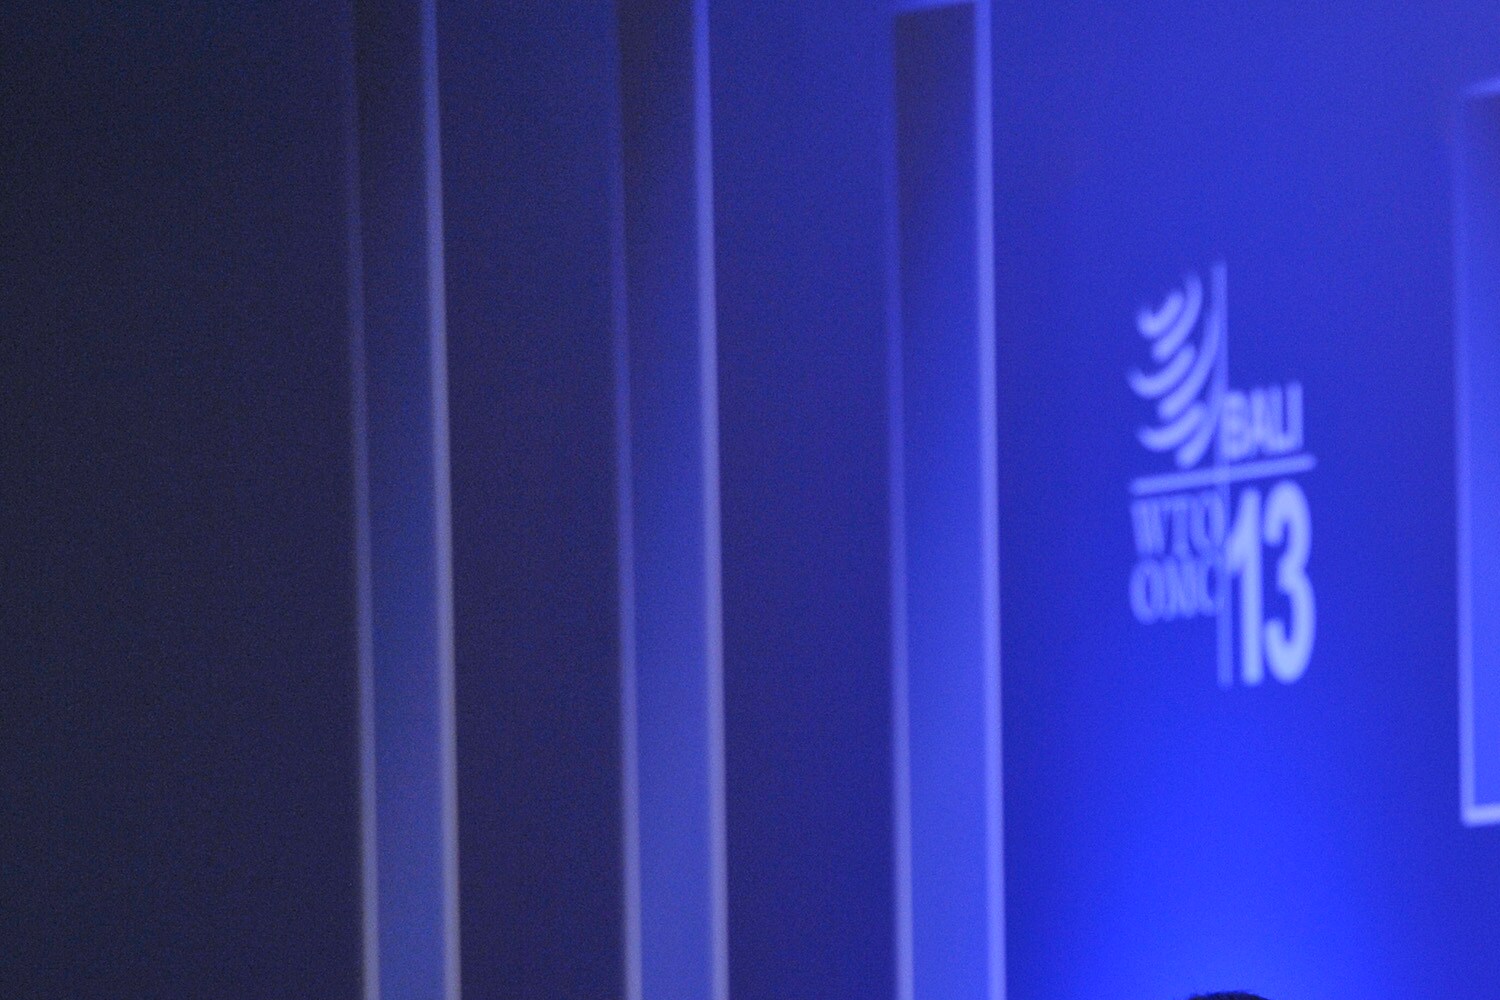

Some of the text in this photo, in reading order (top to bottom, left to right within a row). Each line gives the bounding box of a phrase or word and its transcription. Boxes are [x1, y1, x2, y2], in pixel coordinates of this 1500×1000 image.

[1222, 382, 1304, 459] BALI
[1130, 492, 1226, 558] WTO
[1227, 481, 1317, 687] 13
